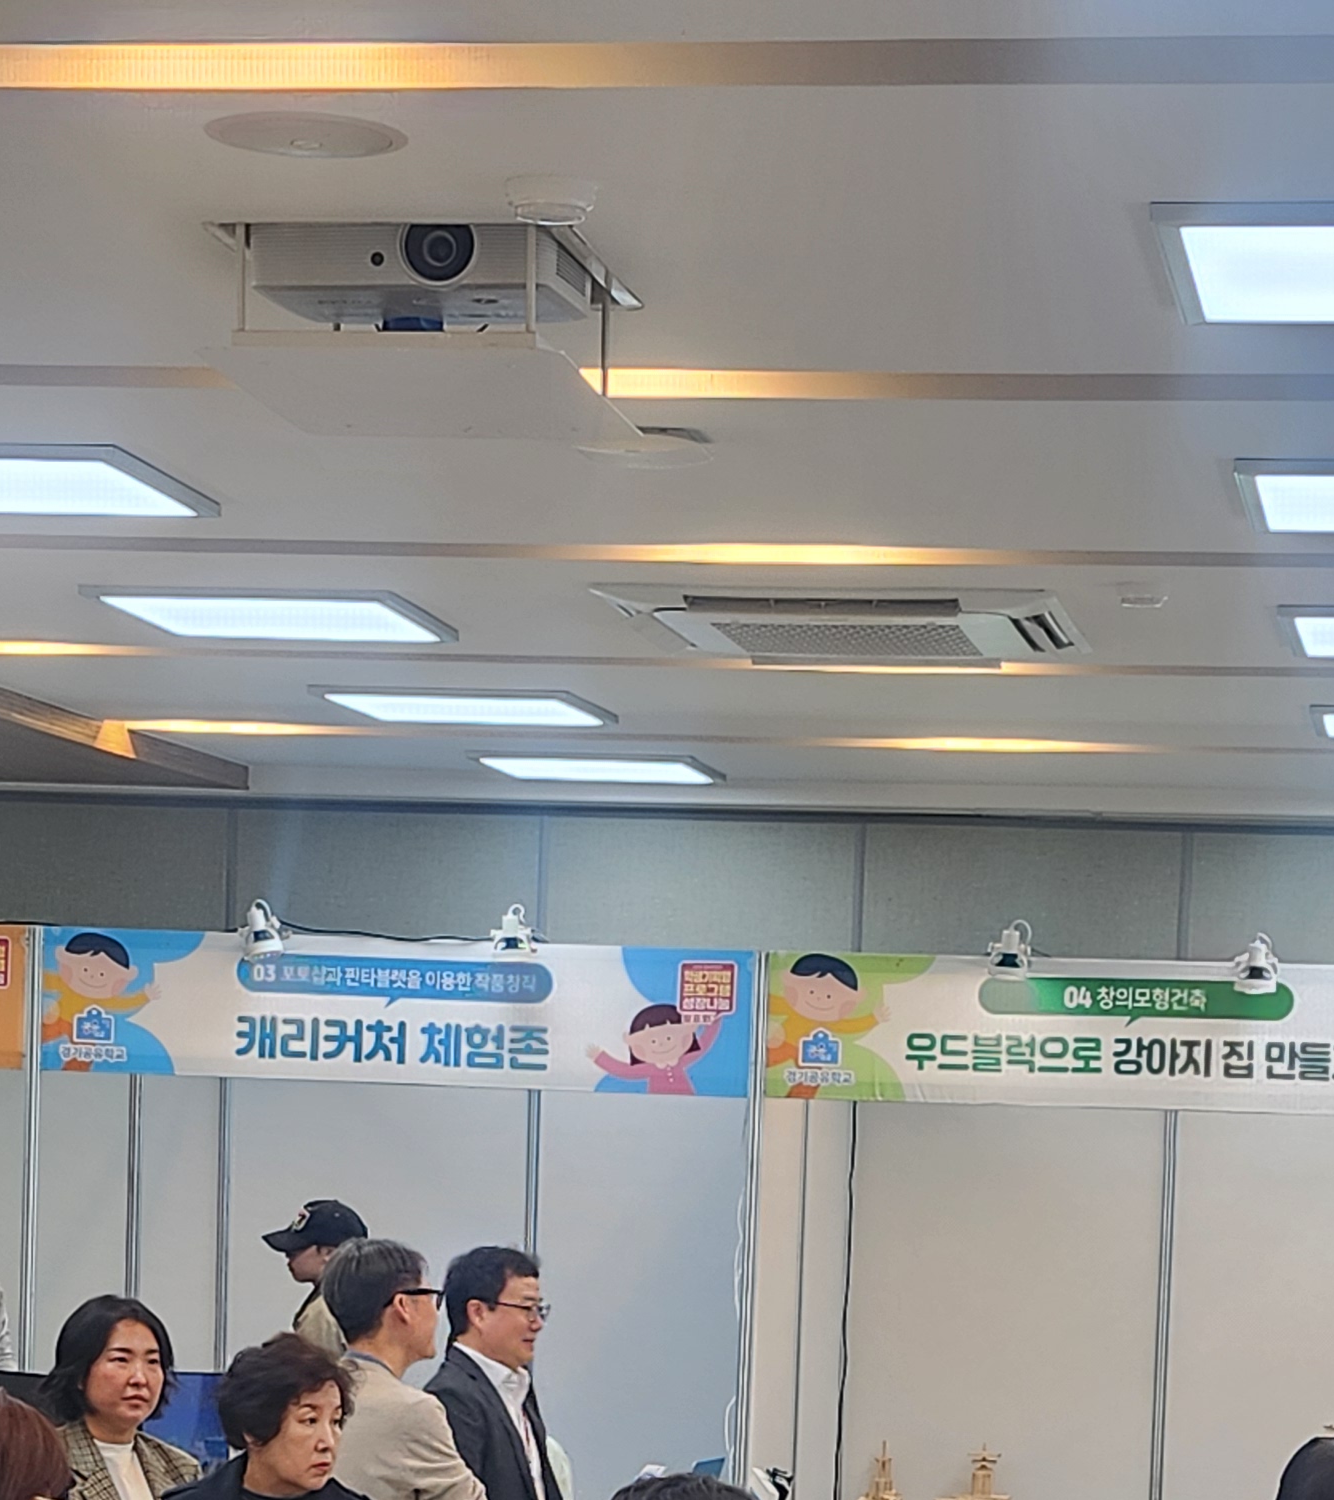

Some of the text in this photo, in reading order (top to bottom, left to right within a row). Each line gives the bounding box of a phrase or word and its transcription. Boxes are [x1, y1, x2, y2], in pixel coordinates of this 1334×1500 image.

[253, 964, 276, 982] 03
[425, 970, 472, 991] 이용한
[1063, 985, 1208, 1013] 04 창의모형건축
[234, 1014, 550, 1071] 캐리커처 체험존
[904, 1032, 1103, 1074] 우드블럭으로
[1112, 1036, 1213, 1079] 강아지
[1221, 1039, 1255, 1080] 집
